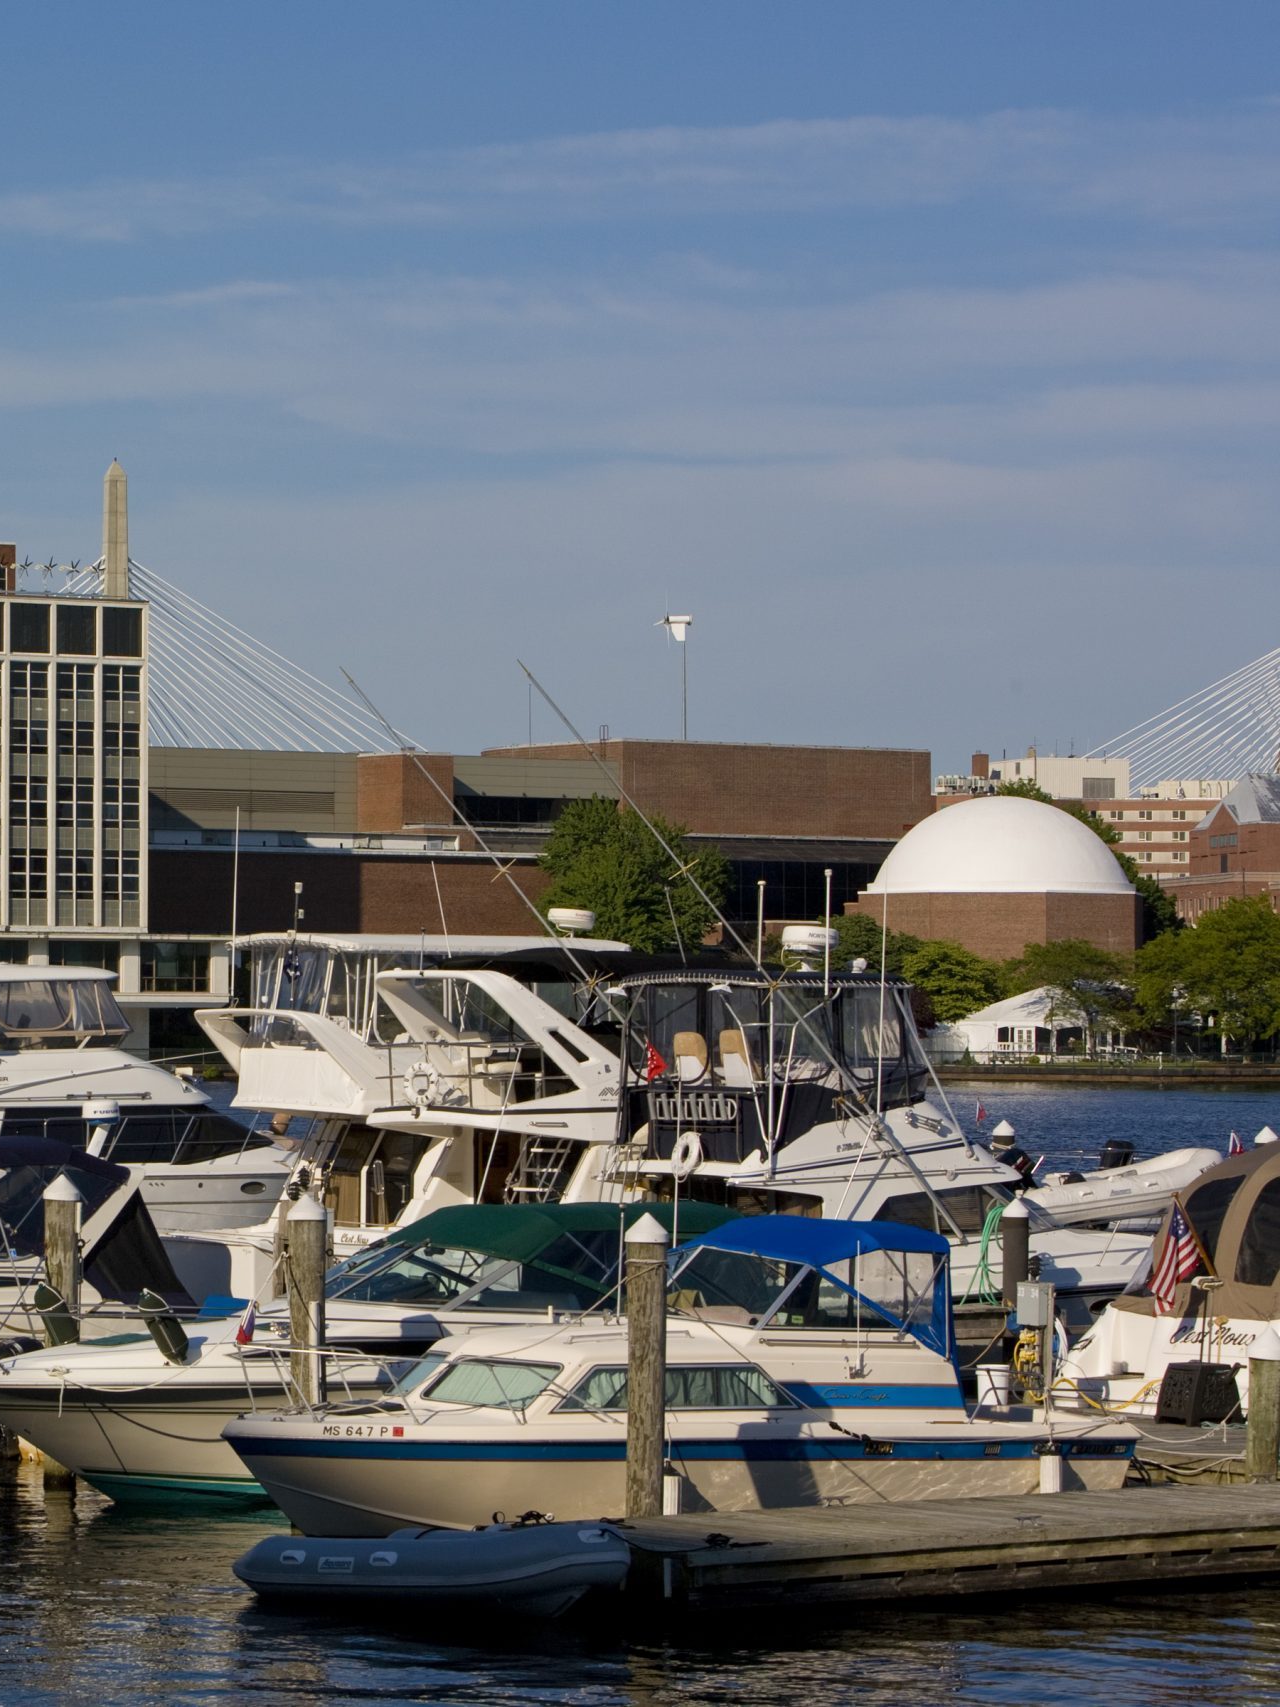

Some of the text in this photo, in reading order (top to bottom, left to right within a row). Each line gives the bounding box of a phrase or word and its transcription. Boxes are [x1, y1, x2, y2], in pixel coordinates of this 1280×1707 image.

[322, 1426, 389, 1437] MS 647 P
